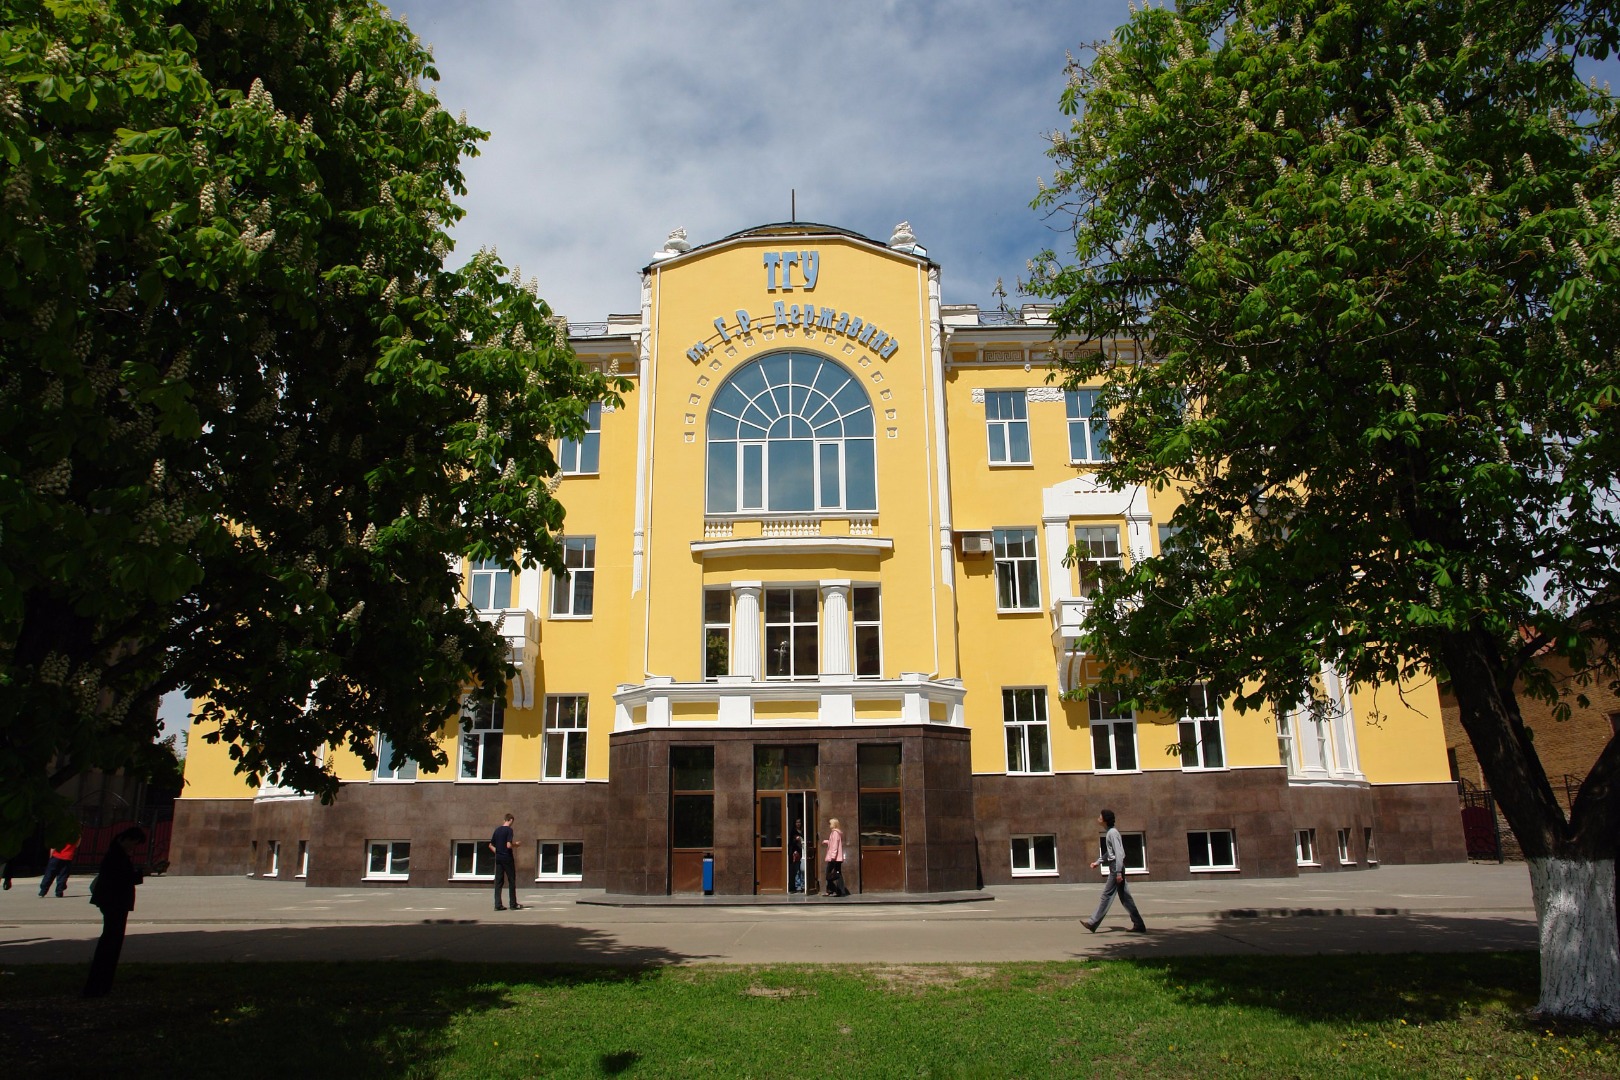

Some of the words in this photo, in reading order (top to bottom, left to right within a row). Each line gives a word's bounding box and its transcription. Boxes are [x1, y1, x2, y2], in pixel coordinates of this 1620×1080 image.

[763, 251, 819, 290] ТГУ
[686, 340, 713, 362] им.
[773, 300, 899, 359] Державина
